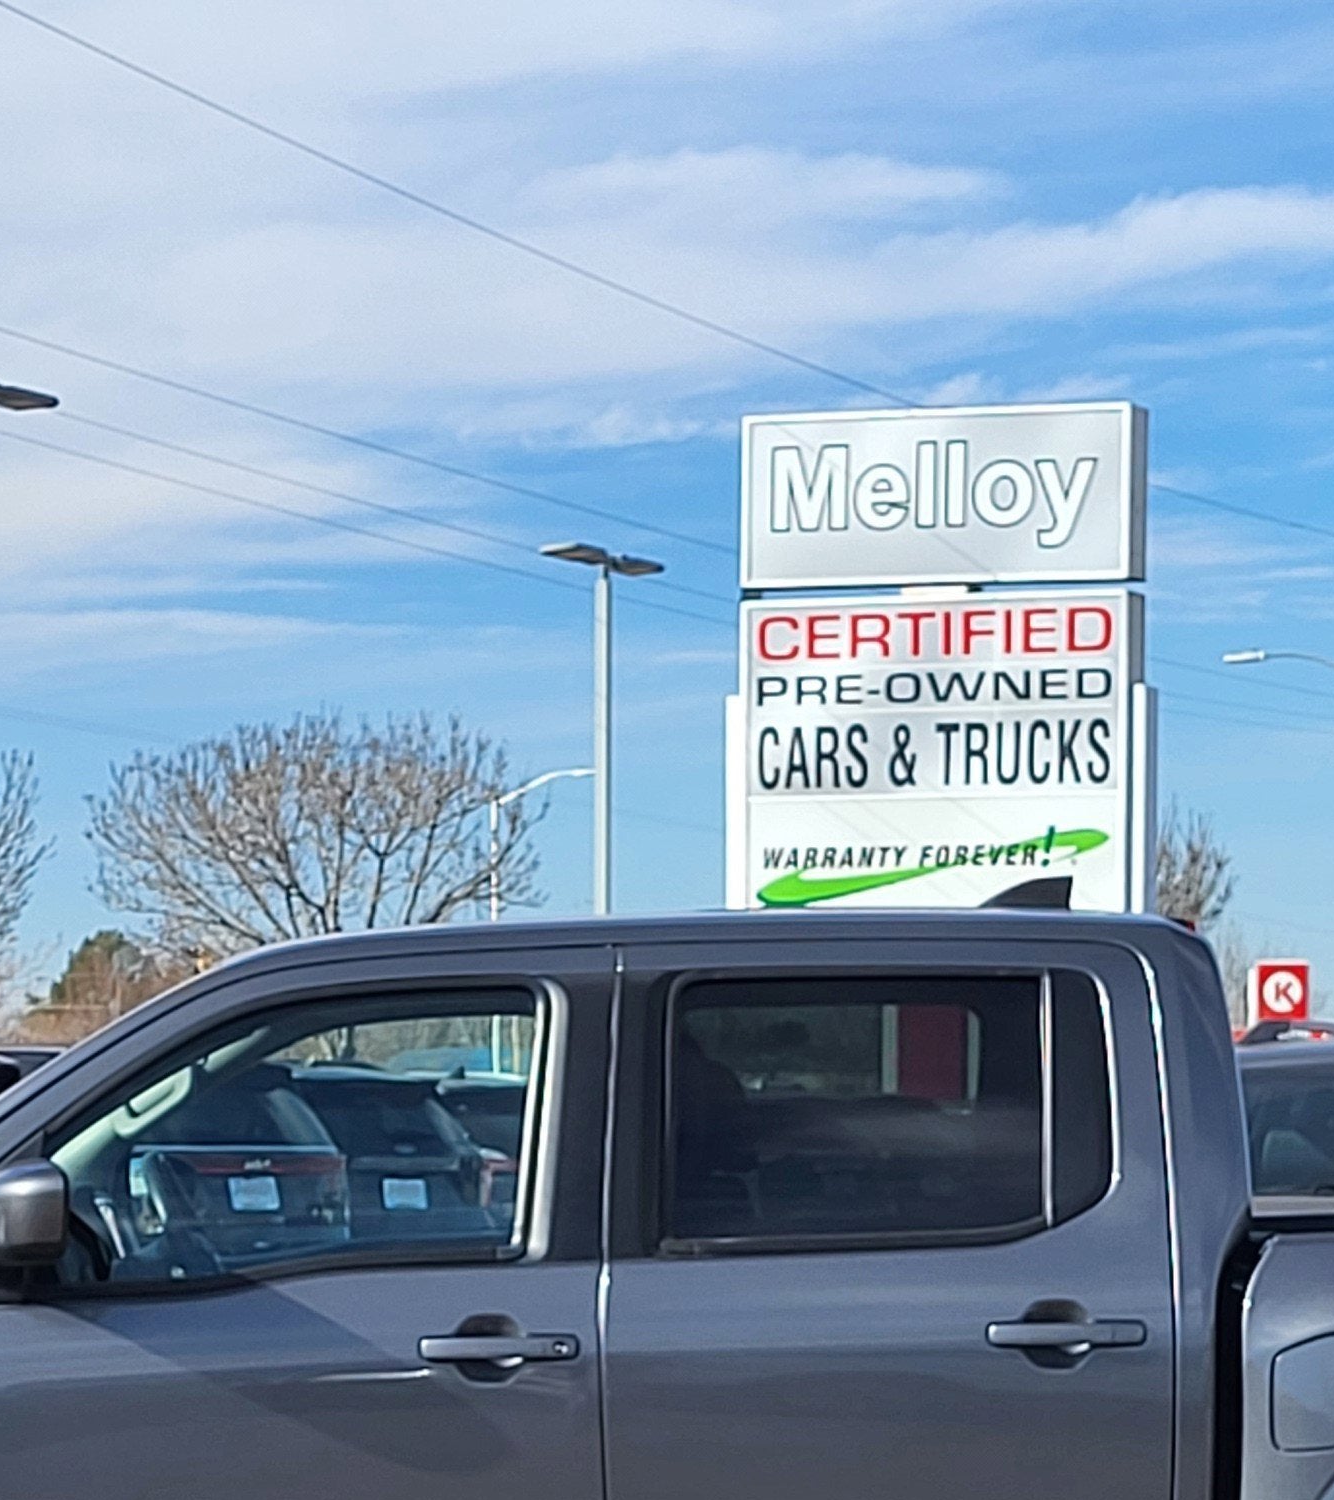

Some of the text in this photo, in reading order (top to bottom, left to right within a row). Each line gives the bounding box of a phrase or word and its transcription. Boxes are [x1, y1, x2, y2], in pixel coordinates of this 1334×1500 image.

[769, 439, 1099, 550] Melloy
[758, 606, 1113, 661] CERTIFIED
[756, 667, 1113, 707] PRE-OWNED
[758, 717, 1111, 790] CARS & TRUCKS
[762, 846, 908, 870] WARRANTY
[1273, 980, 1297, 1006] K
